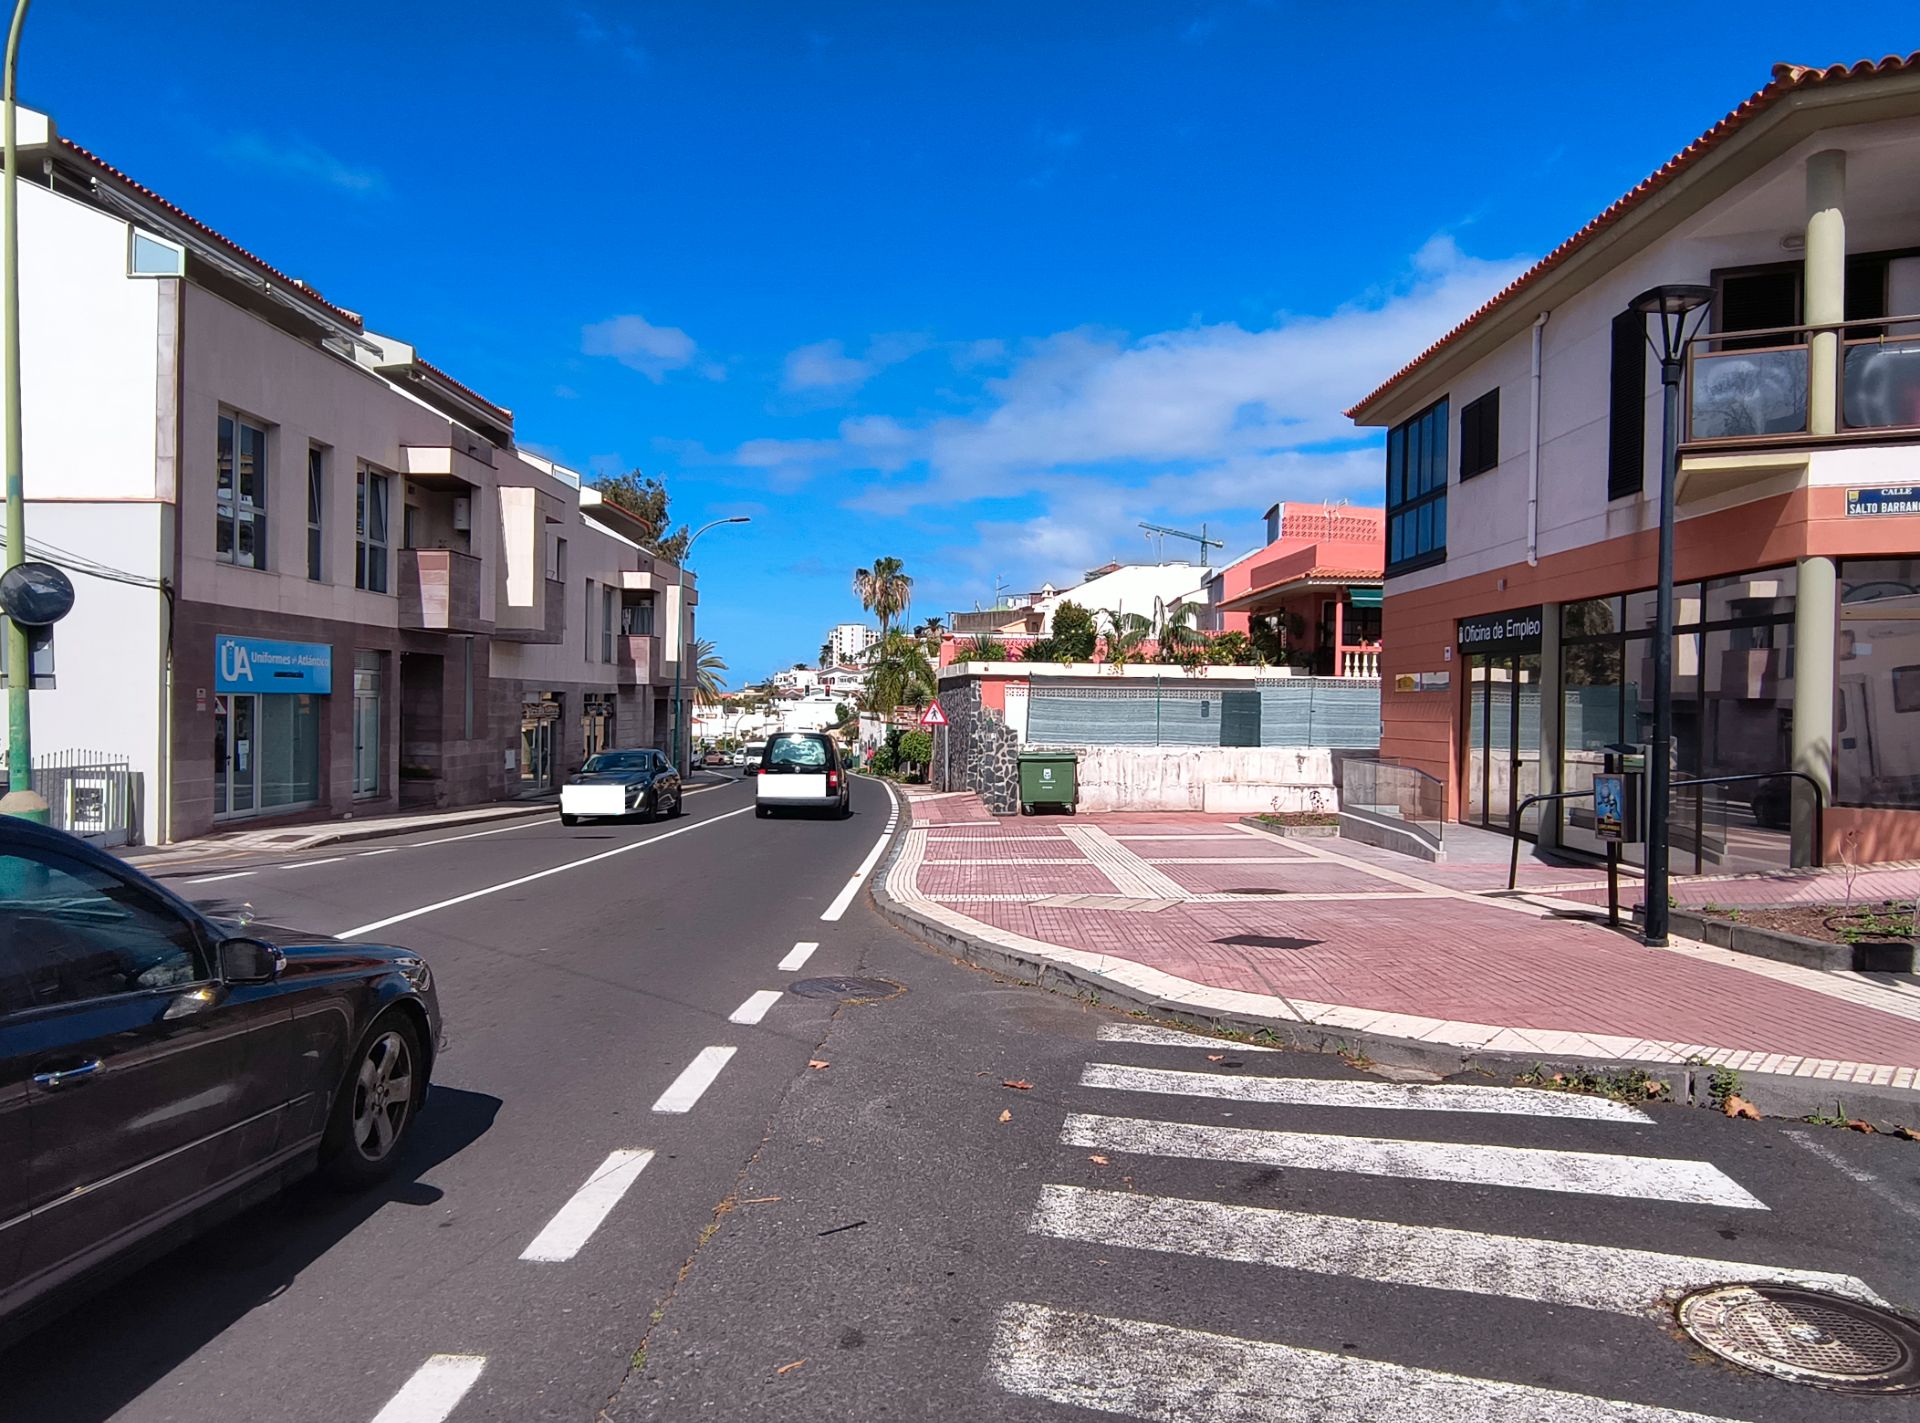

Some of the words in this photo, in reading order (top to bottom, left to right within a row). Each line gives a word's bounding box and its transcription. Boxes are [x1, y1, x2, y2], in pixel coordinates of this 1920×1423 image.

[1849, 503, 1878, 514] SALTO
[1464, 624, 1491, 643] Oficina
[1492, 621, 1503, 640] de
[1506, 617, 1541, 640] Empleo
[251, 651, 291, 664] Uniformes
[297, 654, 329, 667] Atlántico
